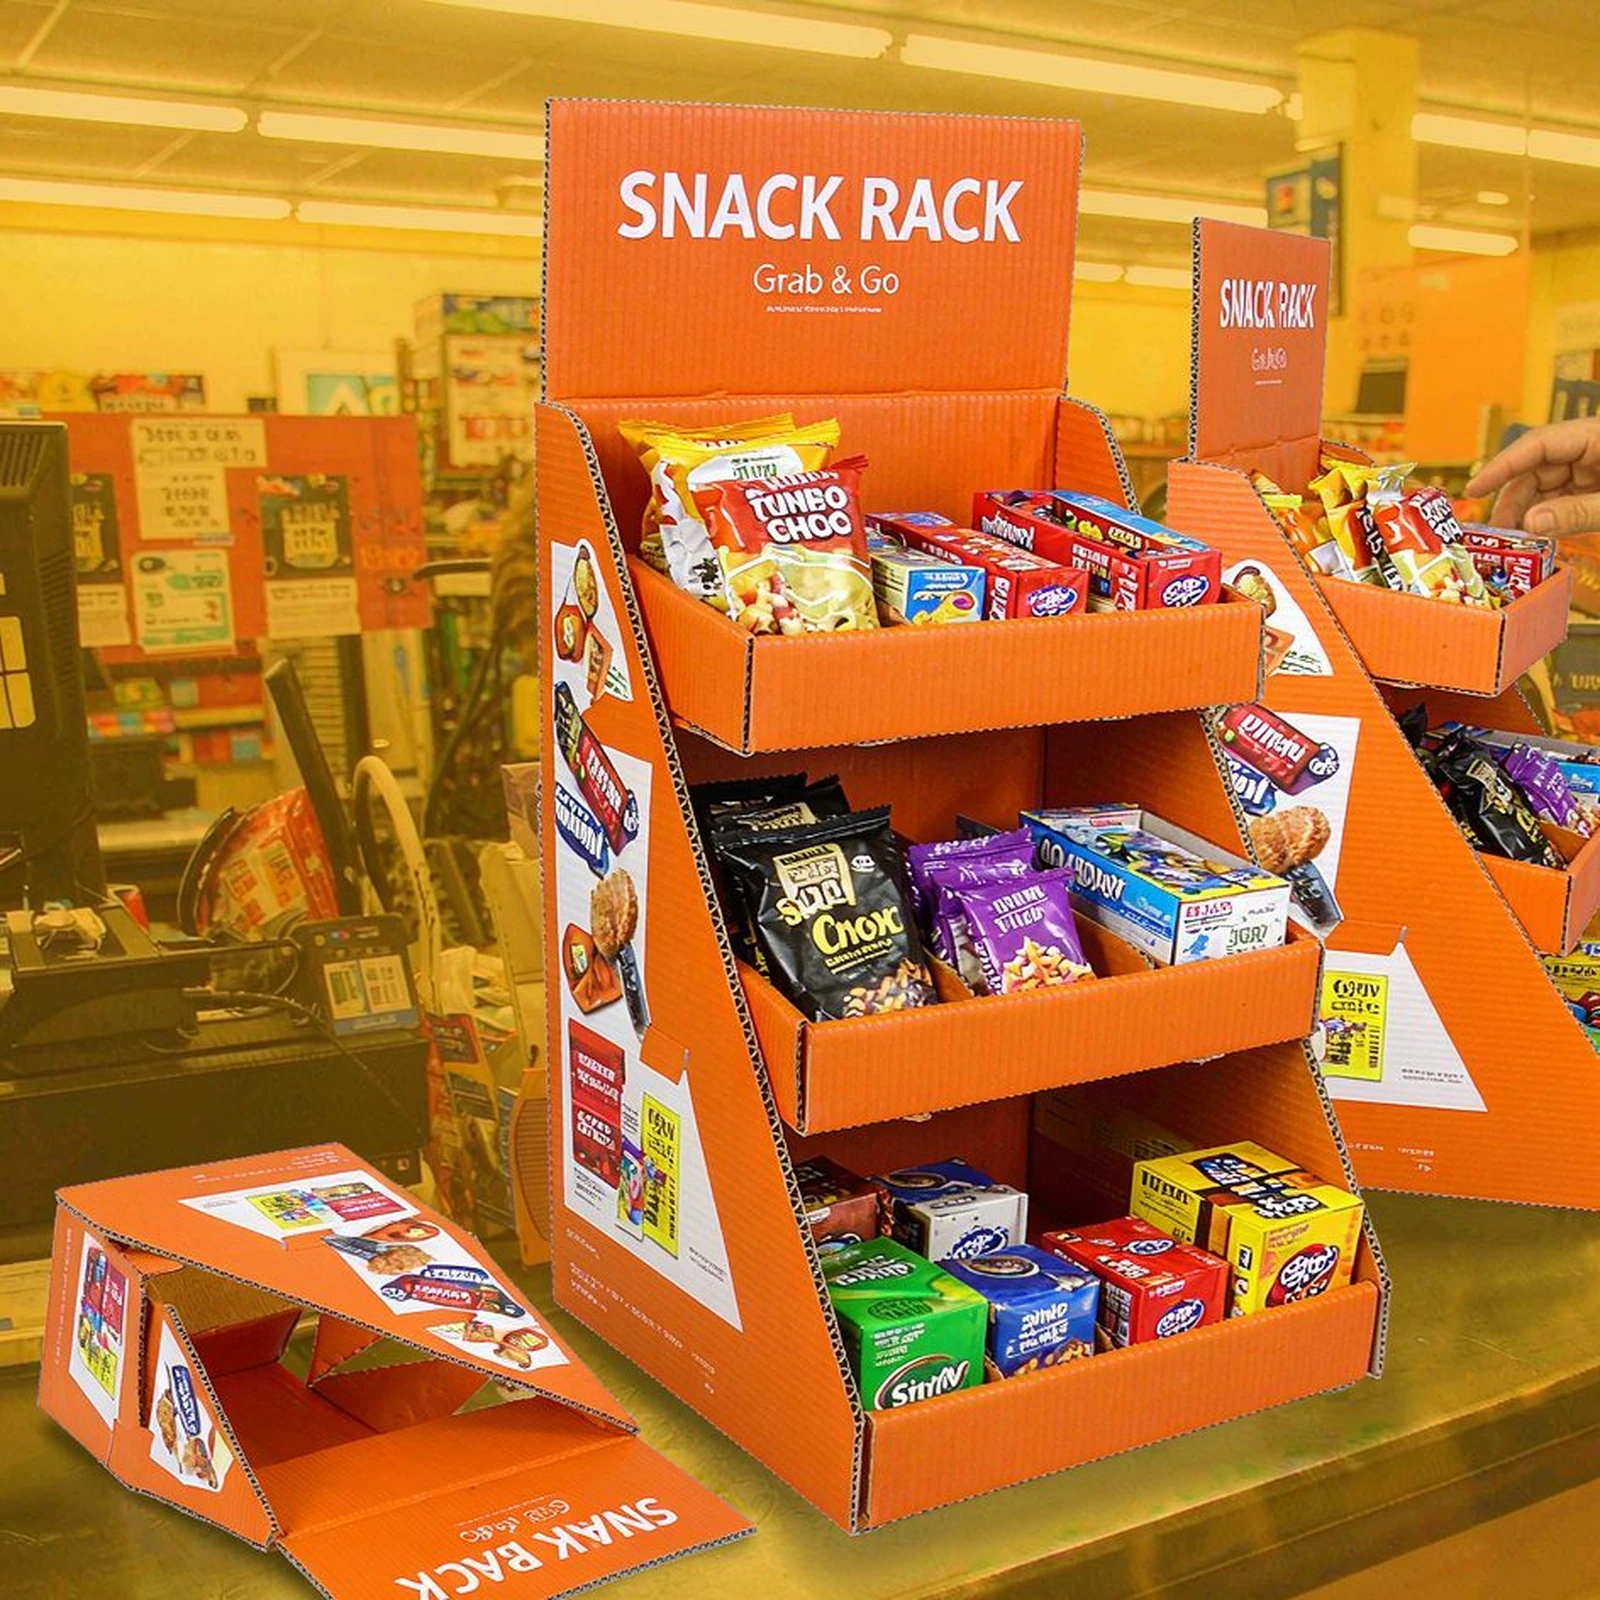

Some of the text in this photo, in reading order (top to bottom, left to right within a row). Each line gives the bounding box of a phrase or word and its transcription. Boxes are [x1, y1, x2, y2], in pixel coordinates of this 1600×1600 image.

[617, 170, 1025, 244] SNACK RACK
[752, 264, 900, 295] Grab & Go
[1219, 279, 1275, 328] SNACK
[532, 1497, 679, 1560] SNAK
